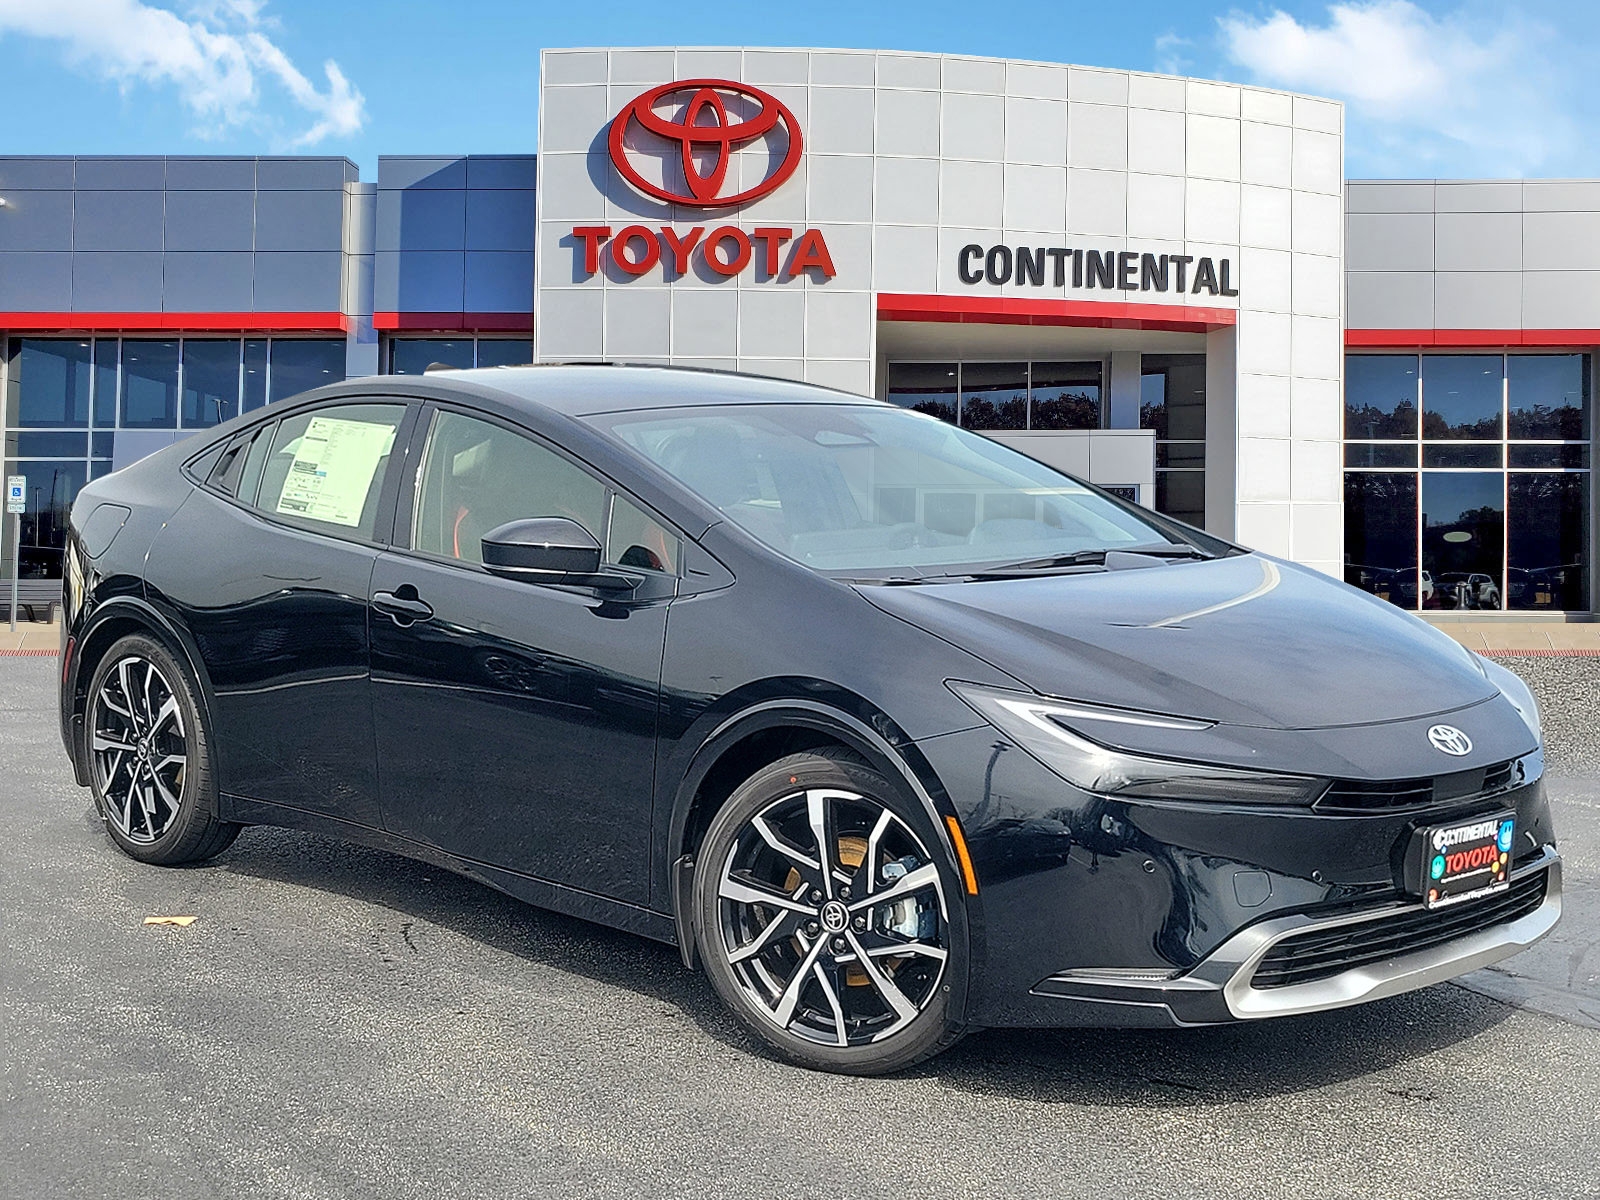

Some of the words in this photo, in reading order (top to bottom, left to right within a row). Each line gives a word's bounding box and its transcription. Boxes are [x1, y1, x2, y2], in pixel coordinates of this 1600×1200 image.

[573, 225, 837, 277] TOYOTA
[959, 244, 1239, 297] CONTINENTAL
[1433, 820, 1498, 850] CONTINENTAL
[1446, 846, 1498, 873] TOYOTA
